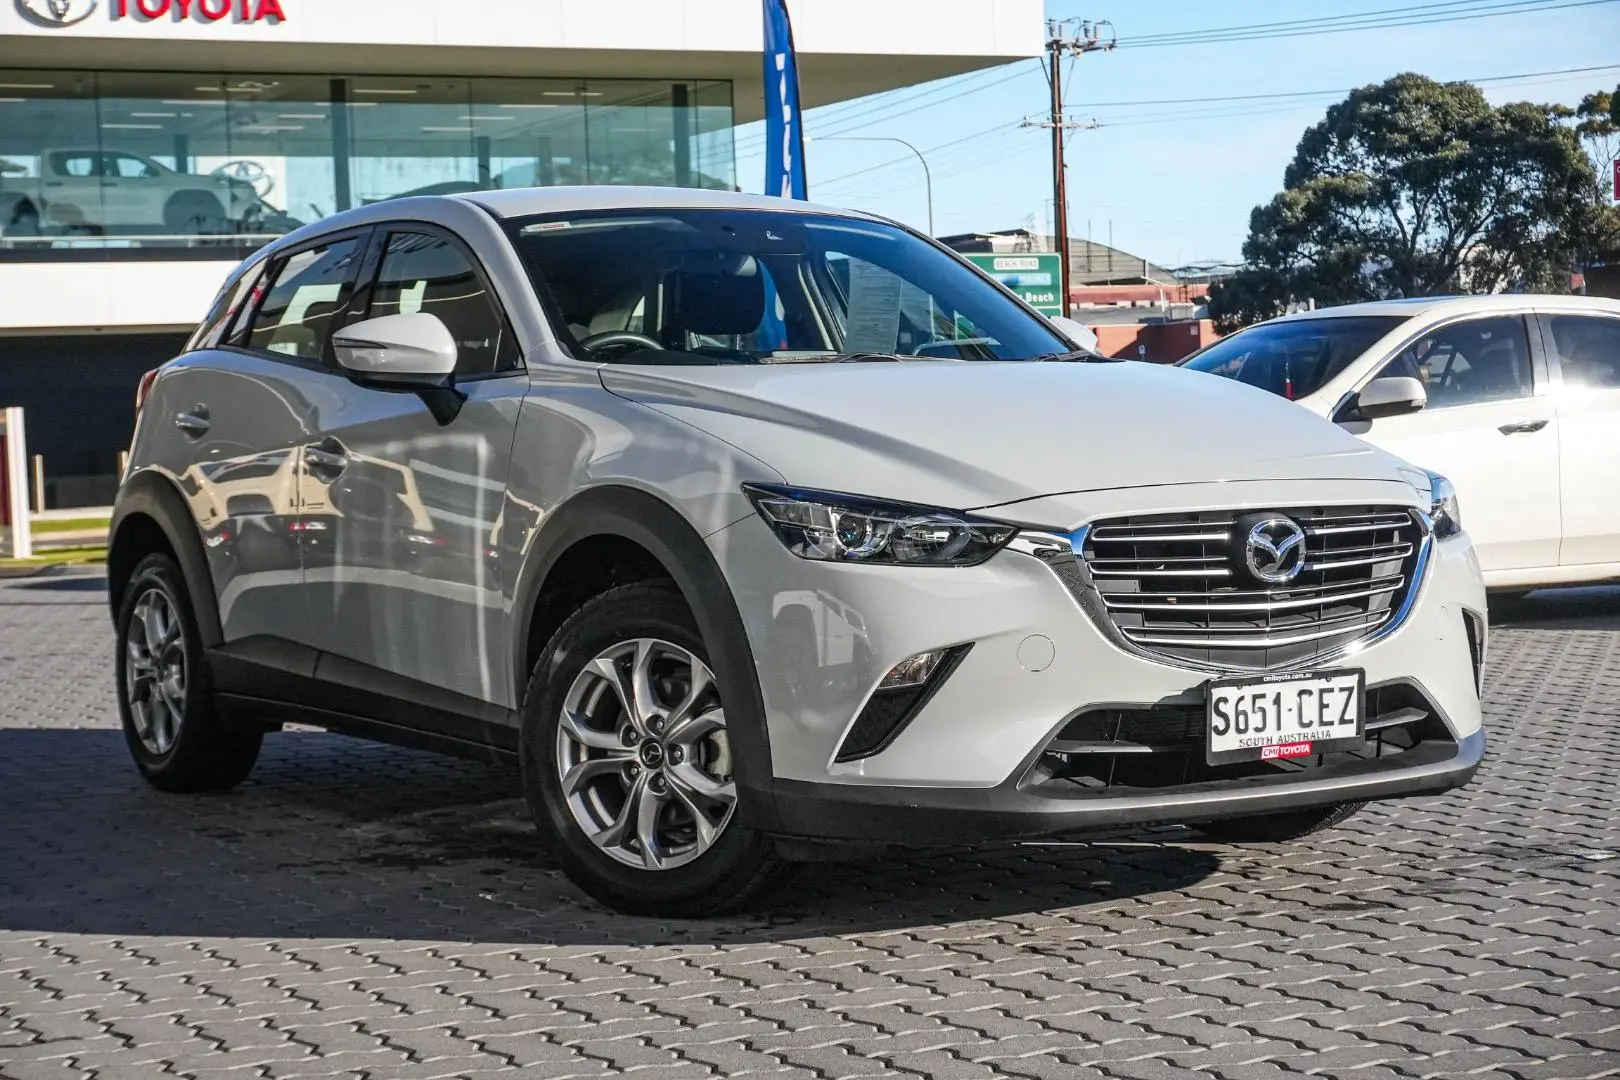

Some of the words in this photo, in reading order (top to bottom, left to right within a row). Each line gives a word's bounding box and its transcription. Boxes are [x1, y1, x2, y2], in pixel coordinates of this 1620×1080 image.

[1025, 292, 1054, 302] Beach
[1239, 736, 1273, 748] SOUTH
[1277, 730, 1332, 744] AUSTRALIA
[1279, 744, 1310, 755] TOYOTA
